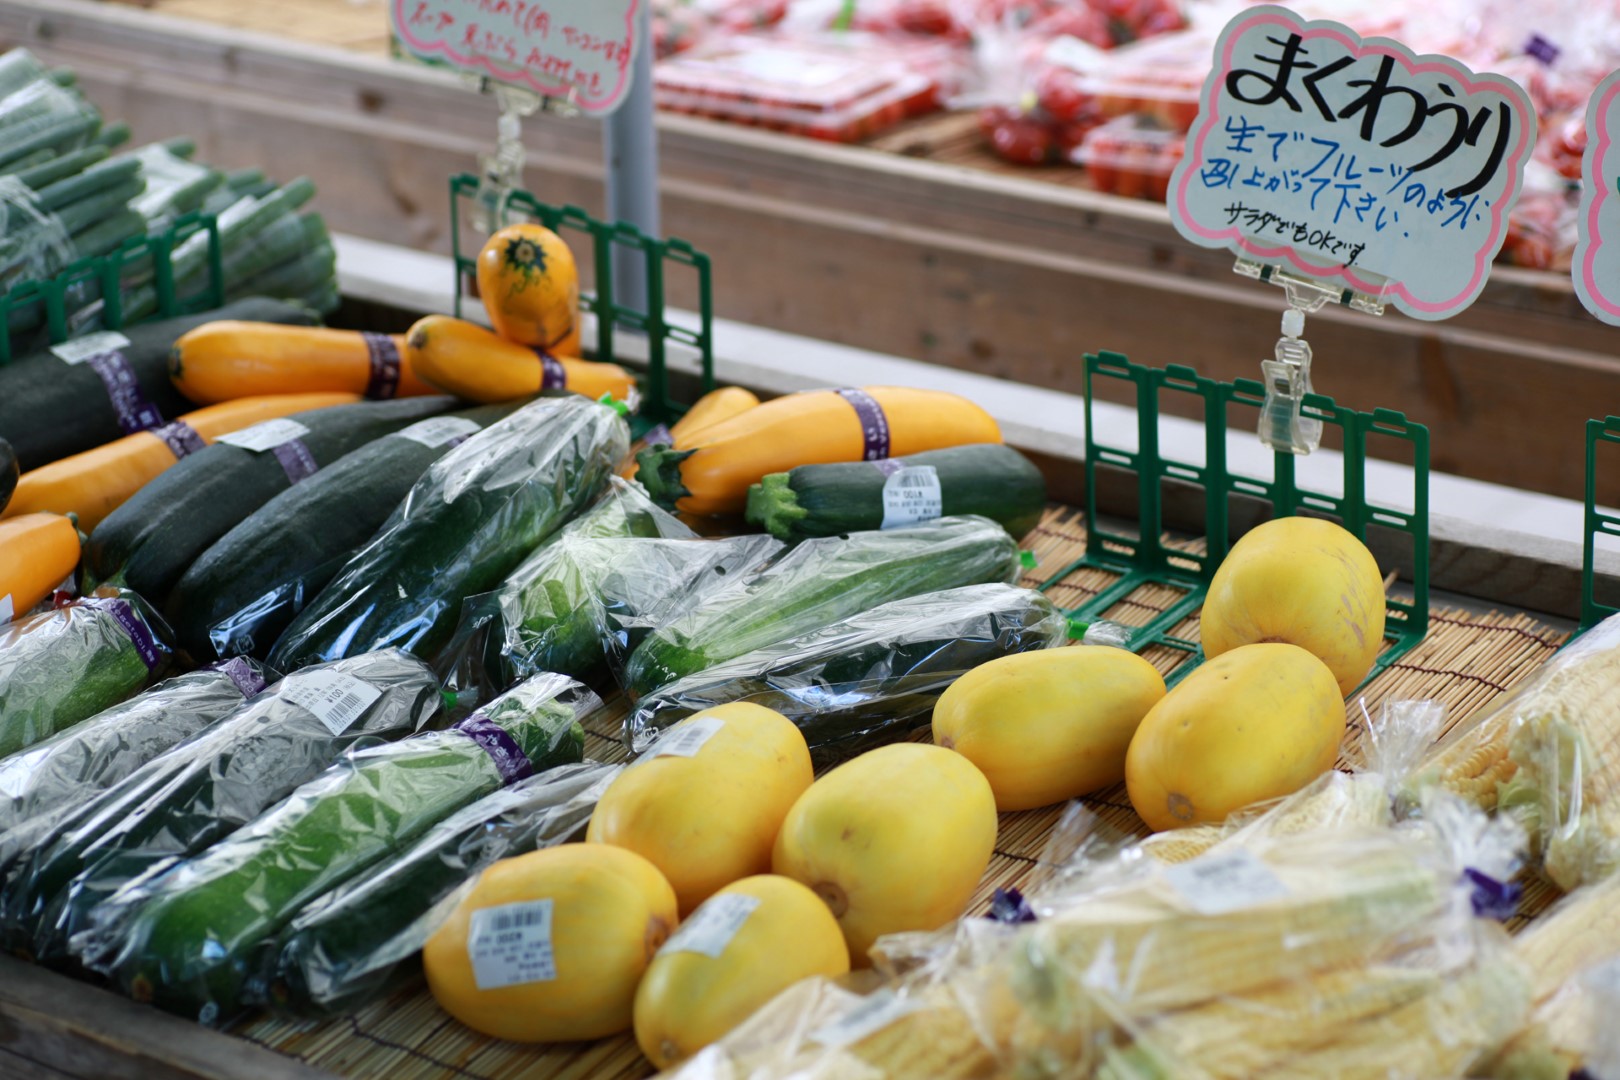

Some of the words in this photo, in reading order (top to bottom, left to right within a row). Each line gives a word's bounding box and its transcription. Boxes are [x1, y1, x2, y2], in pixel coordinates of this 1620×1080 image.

[1225, 115, 1490, 230] 生でフルーツのように
[1226, 33, 1511, 199] まくわうり
[325, 689, 344, 703] ¥100
